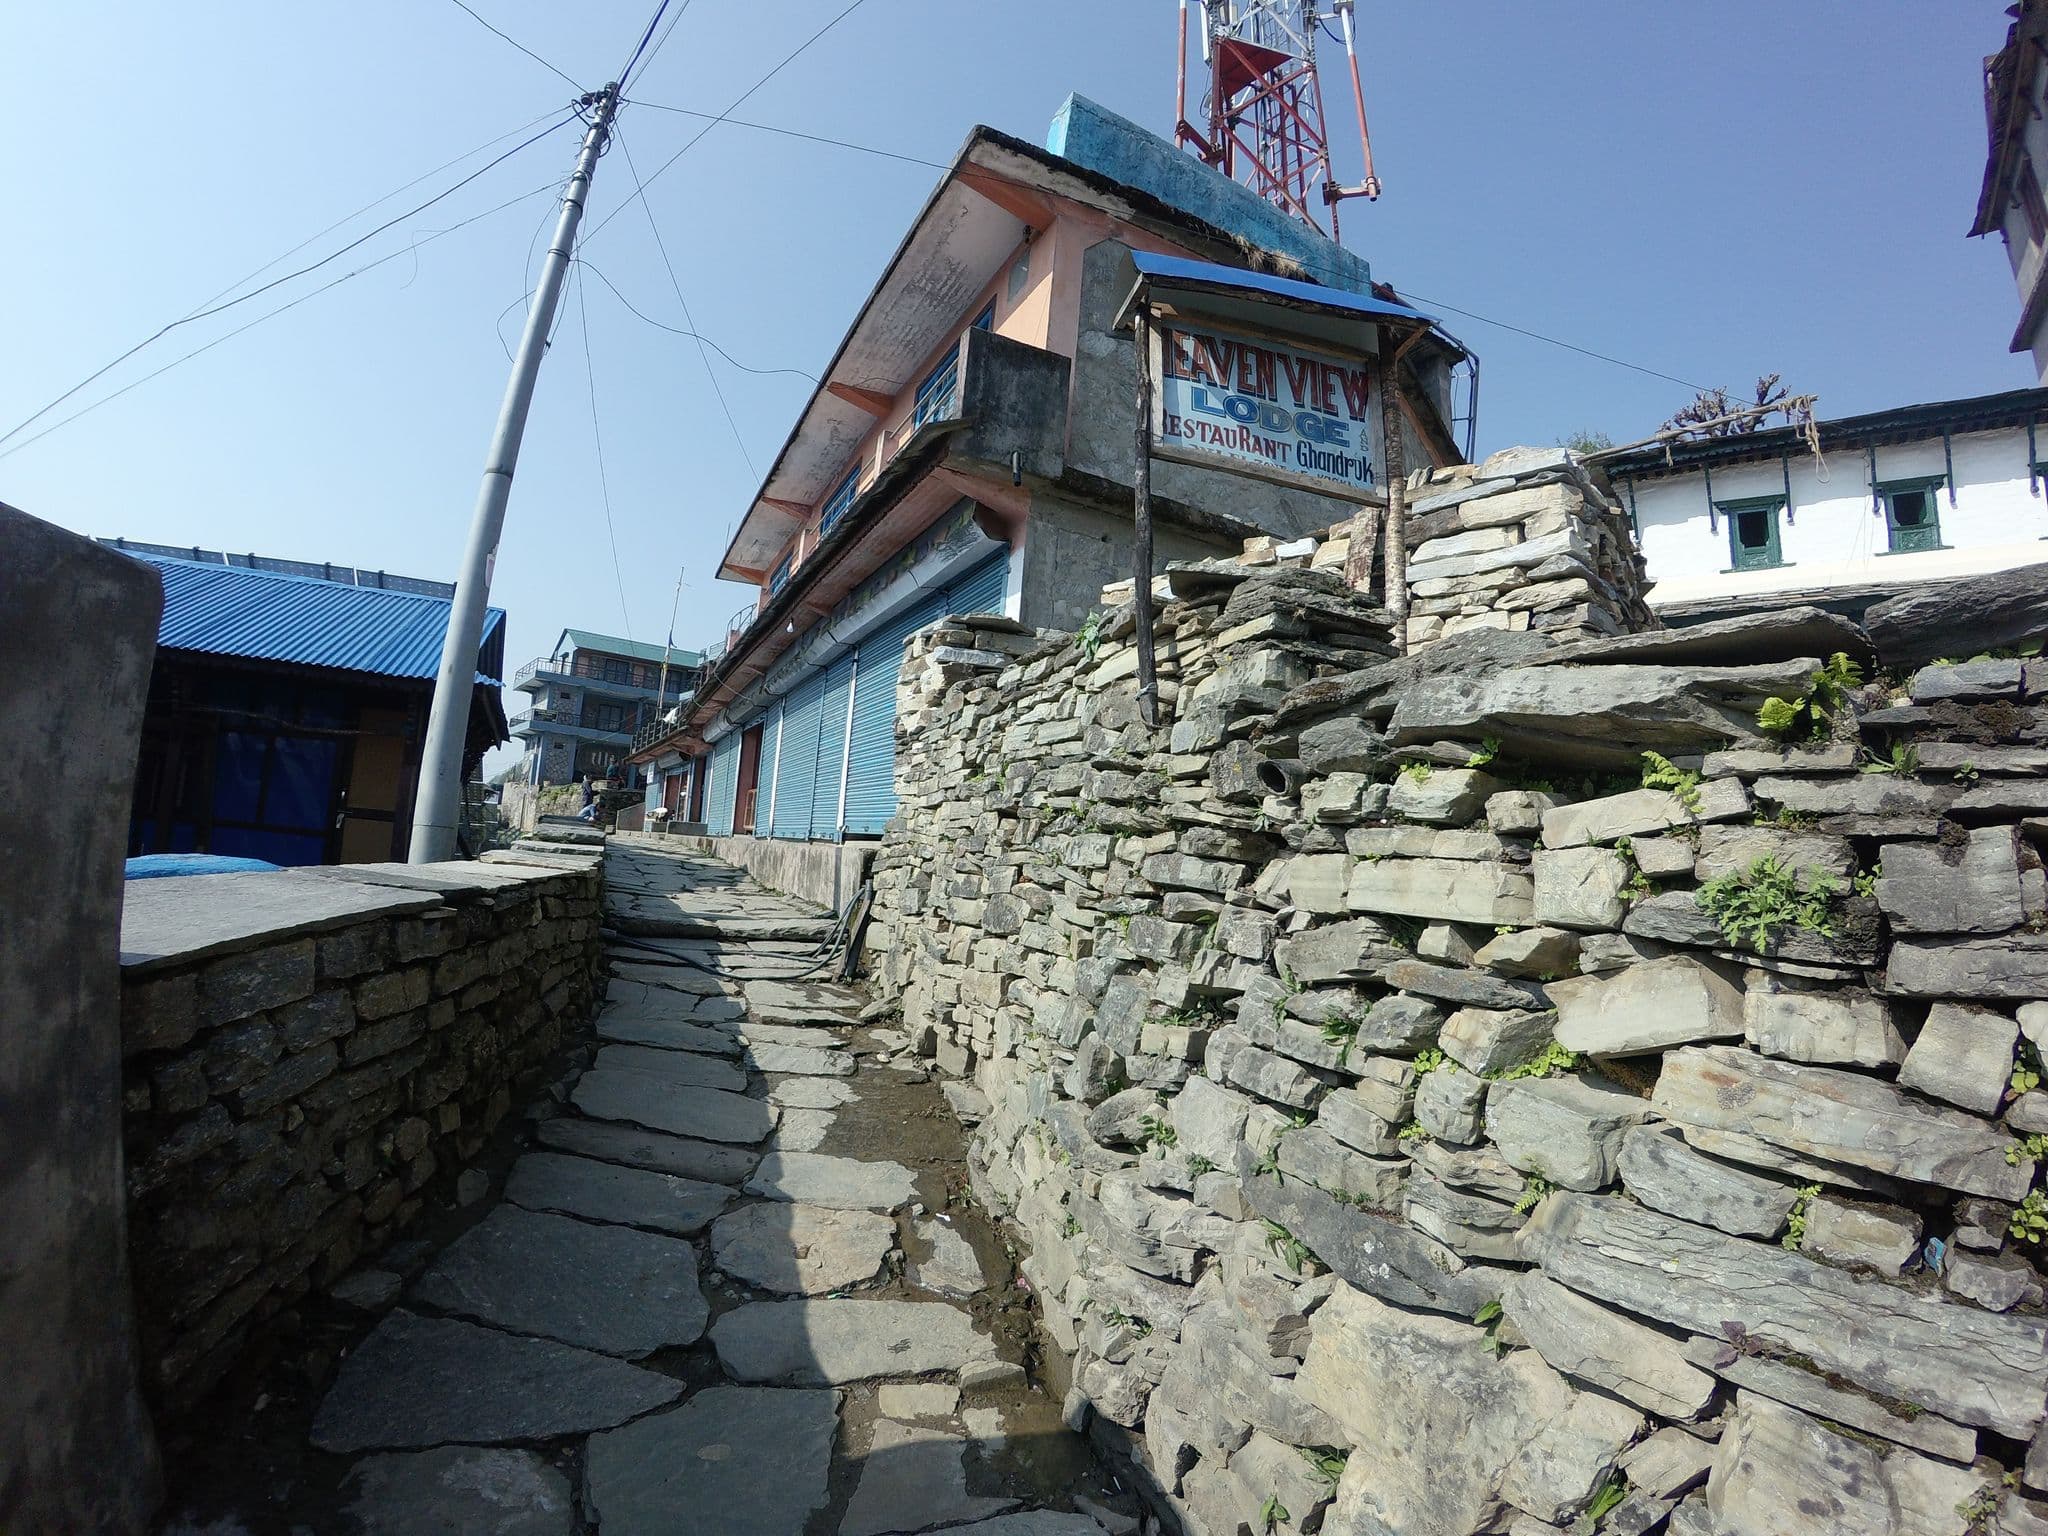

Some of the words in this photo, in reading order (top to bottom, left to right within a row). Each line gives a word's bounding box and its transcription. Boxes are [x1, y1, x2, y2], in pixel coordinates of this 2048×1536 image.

[1191, 386, 1350, 448] LODGE
[1277, 353, 1369, 423] VIEW
[1296, 439, 1374, 485] Ghandruk
